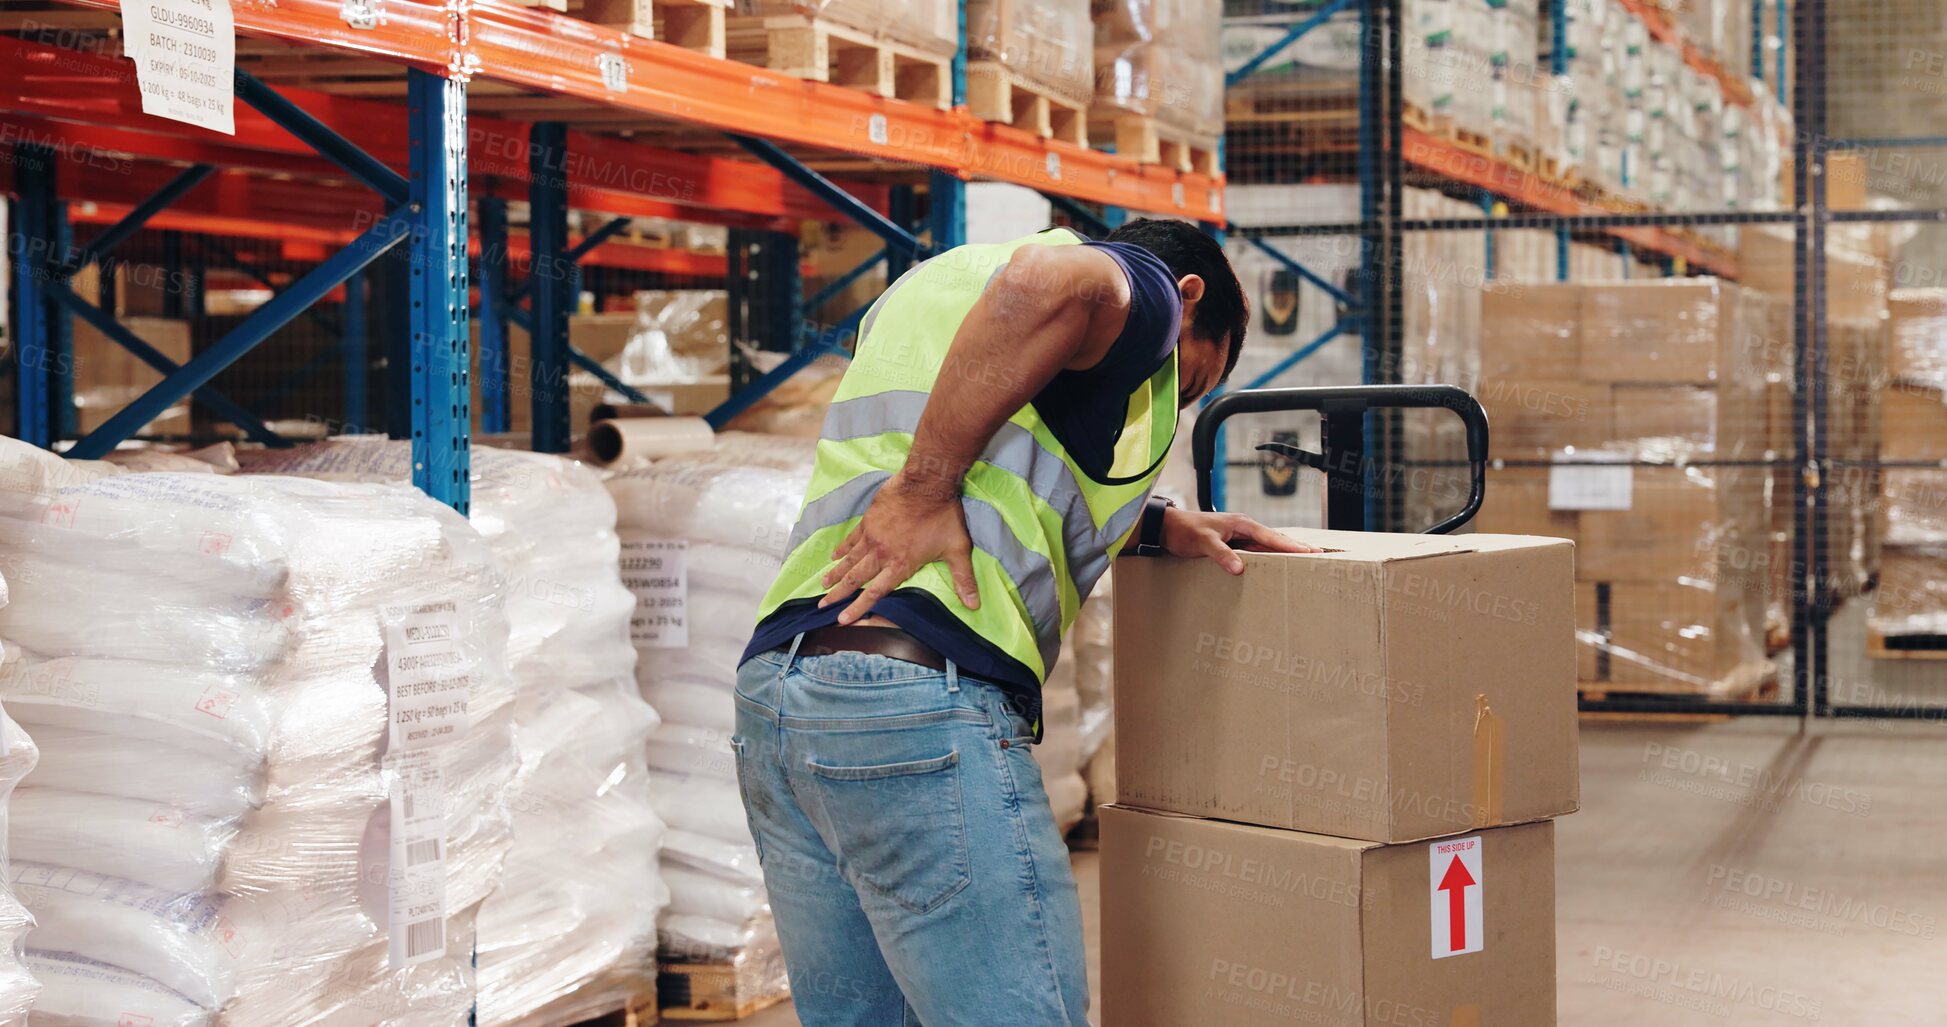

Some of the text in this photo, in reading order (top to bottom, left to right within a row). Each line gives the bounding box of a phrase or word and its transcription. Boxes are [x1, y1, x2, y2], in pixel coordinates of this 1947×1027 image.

[151, 6, 214, 34] GLDU-9960934
[150, 34, 176, 52] BATCH
[184, 42, 216, 62] 2310039
[150, 60, 174, 76] EXPIRY
[179, 68, 216, 87] 05-10-2025
[161, 85, 170, 101] kg
[177, 90, 186, 102] 48
[187, 92, 201, 109] bags
[208, 98, 216, 110] 25
[216, 98, 224, 115] kg
[630, 617, 646, 627] ags
[657, 615, 668, 626] 25
[671, 616, 682, 627] kg
[397, 684, 412, 698] BEST
[413, 680, 437, 696] BEFORE
[415, 709, 422, 723] kg
[436, 705, 448, 719] bags
[453, 702, 460, 714] 25
[461, 701, 467, 714] kg
[1437, 841, 1474, 854] THIS SIDE UP
